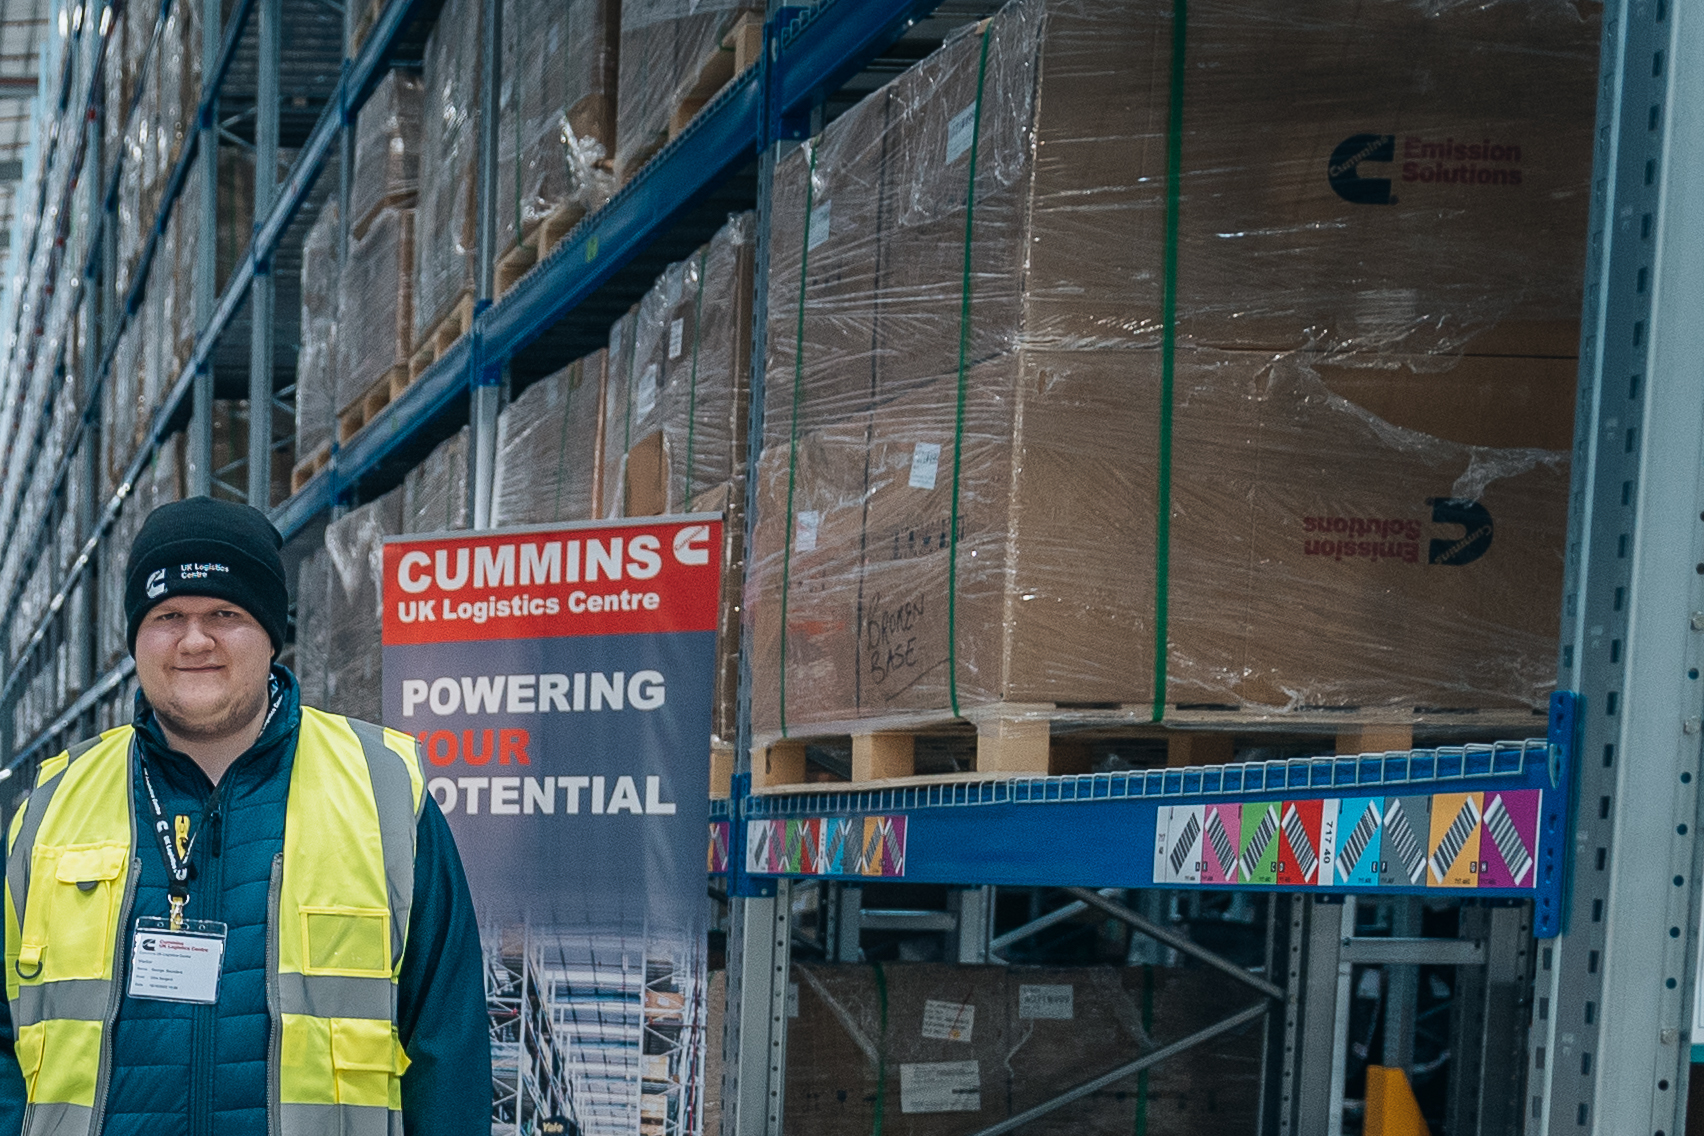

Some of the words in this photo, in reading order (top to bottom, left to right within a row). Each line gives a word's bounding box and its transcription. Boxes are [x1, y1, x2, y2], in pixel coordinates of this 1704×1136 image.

[1403, 137, 1522, 162] Emission
[1401, 161, 1522, 186] Solutions
[1302, 516, 1423, 541] Solutions
[397, 534, 662, 594] CUMMINS
[1304, 540, 1420, 564] Emission
[180, 563, 192, 572] UK
[194, 563, 229, 573] Logistics
[398, 600, 436, 623] UK
[442, 594, 560, 624] Logistics
[568, 589, 660, 614] Centre
[870, 637, 919, 685] BASE
[402, 670, 666, 717] POWERING
[428, 775, 676, 816] OTENTIAL
